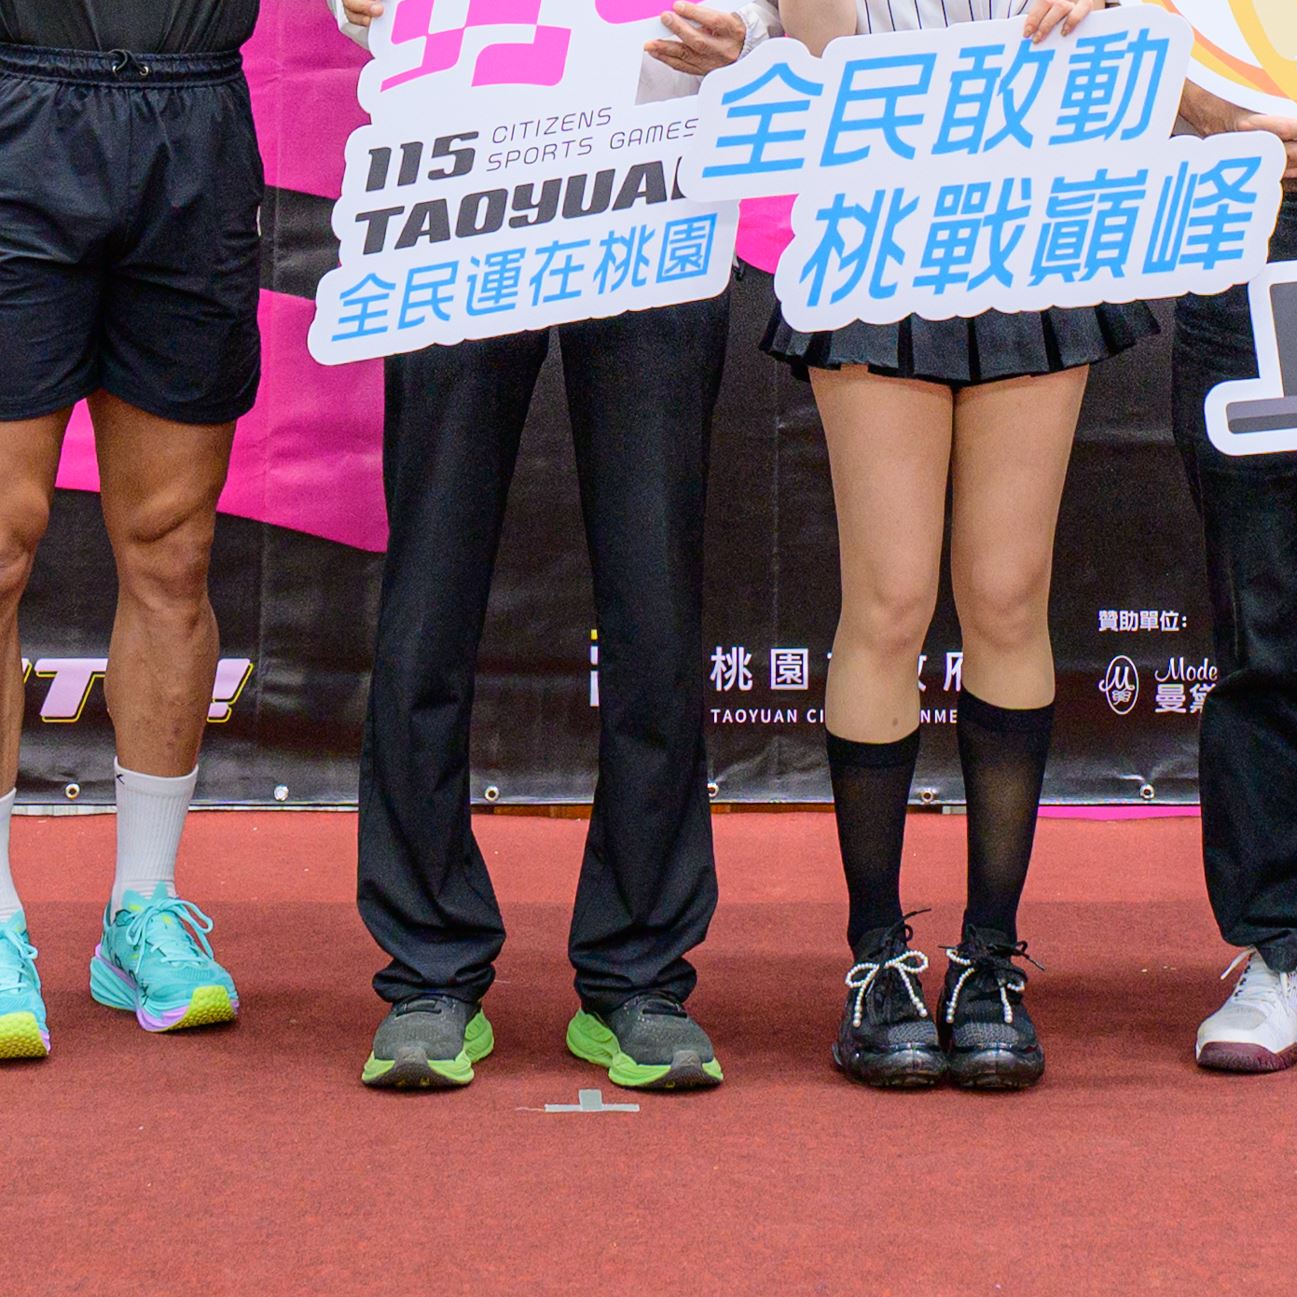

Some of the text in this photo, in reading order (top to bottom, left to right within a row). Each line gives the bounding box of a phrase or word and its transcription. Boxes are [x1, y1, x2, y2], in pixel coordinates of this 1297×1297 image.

[486, 118, 699, 171] SPORTS GAMES
[702, 27, 1170, 179] 全民敢動
[365, 107, 613, 192] 115 CITIZENS
[355, 156, 685, 255] TAOYUA
[798, 155, 1263, 308] 桃戰巔峰
[332, 212, 718, 342] 全民運在桃園
[1154, 656, 1218, 682] Mode
[710, 708, 824, 723] TAOYUAN CI
